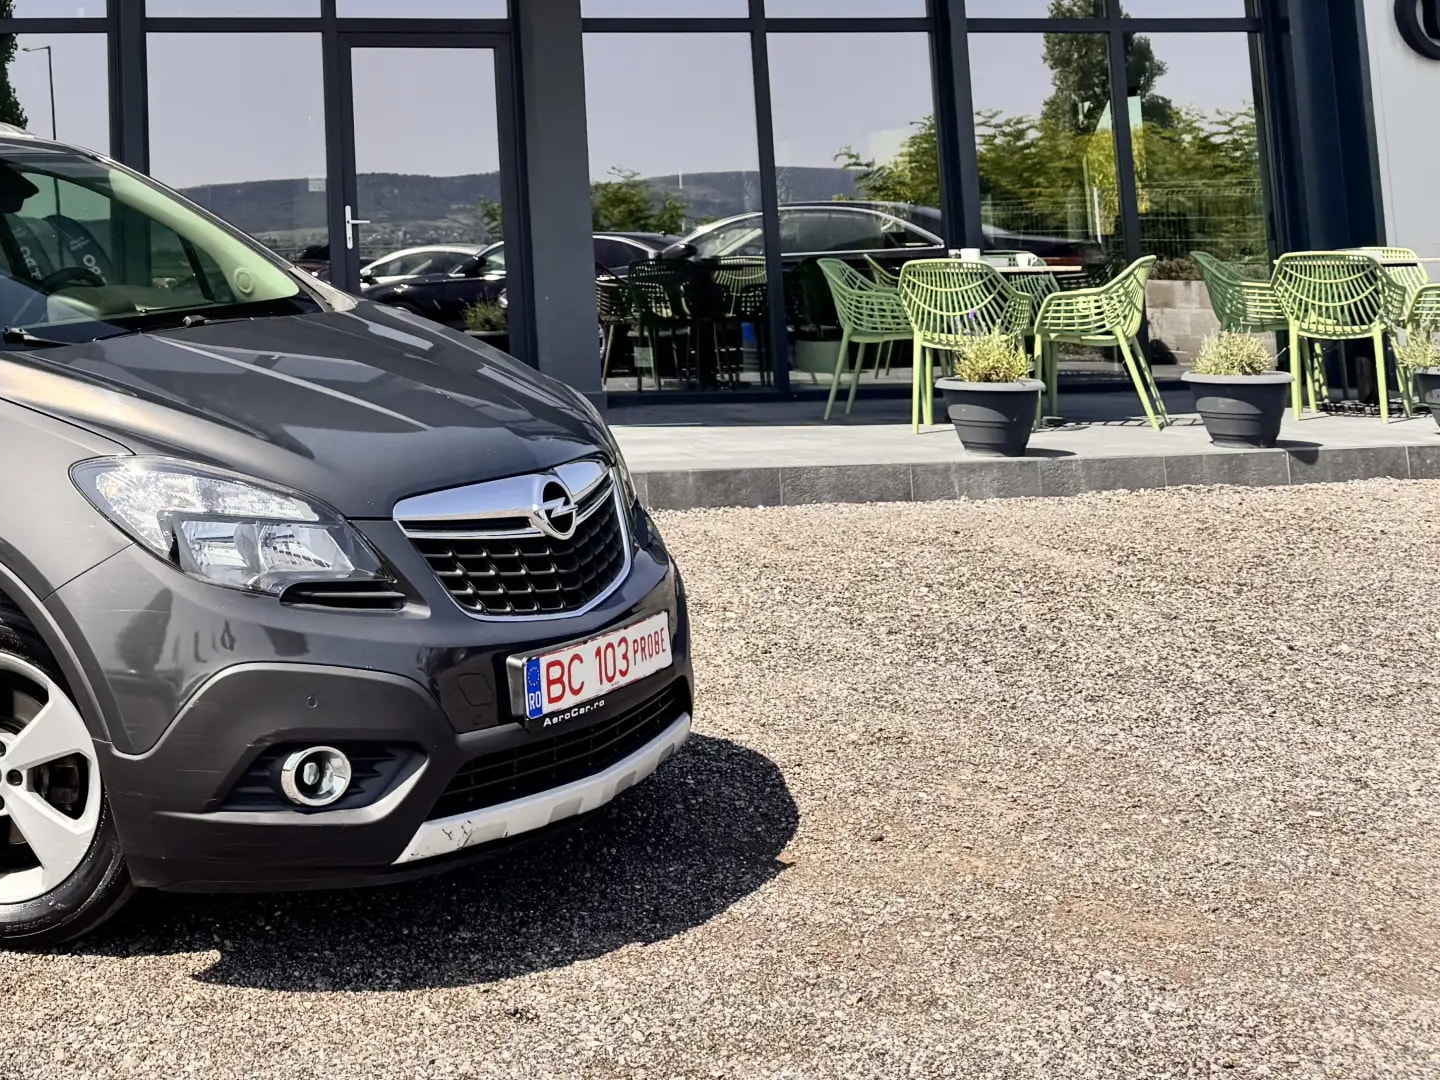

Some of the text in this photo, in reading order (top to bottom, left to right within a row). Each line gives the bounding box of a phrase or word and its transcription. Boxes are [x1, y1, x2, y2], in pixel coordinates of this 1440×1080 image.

[546, 627, 667, 705] BC 103 PROBE
[528, 690, 542, 711] RO
[543, 699, 605, 727] AeroCar.ro
